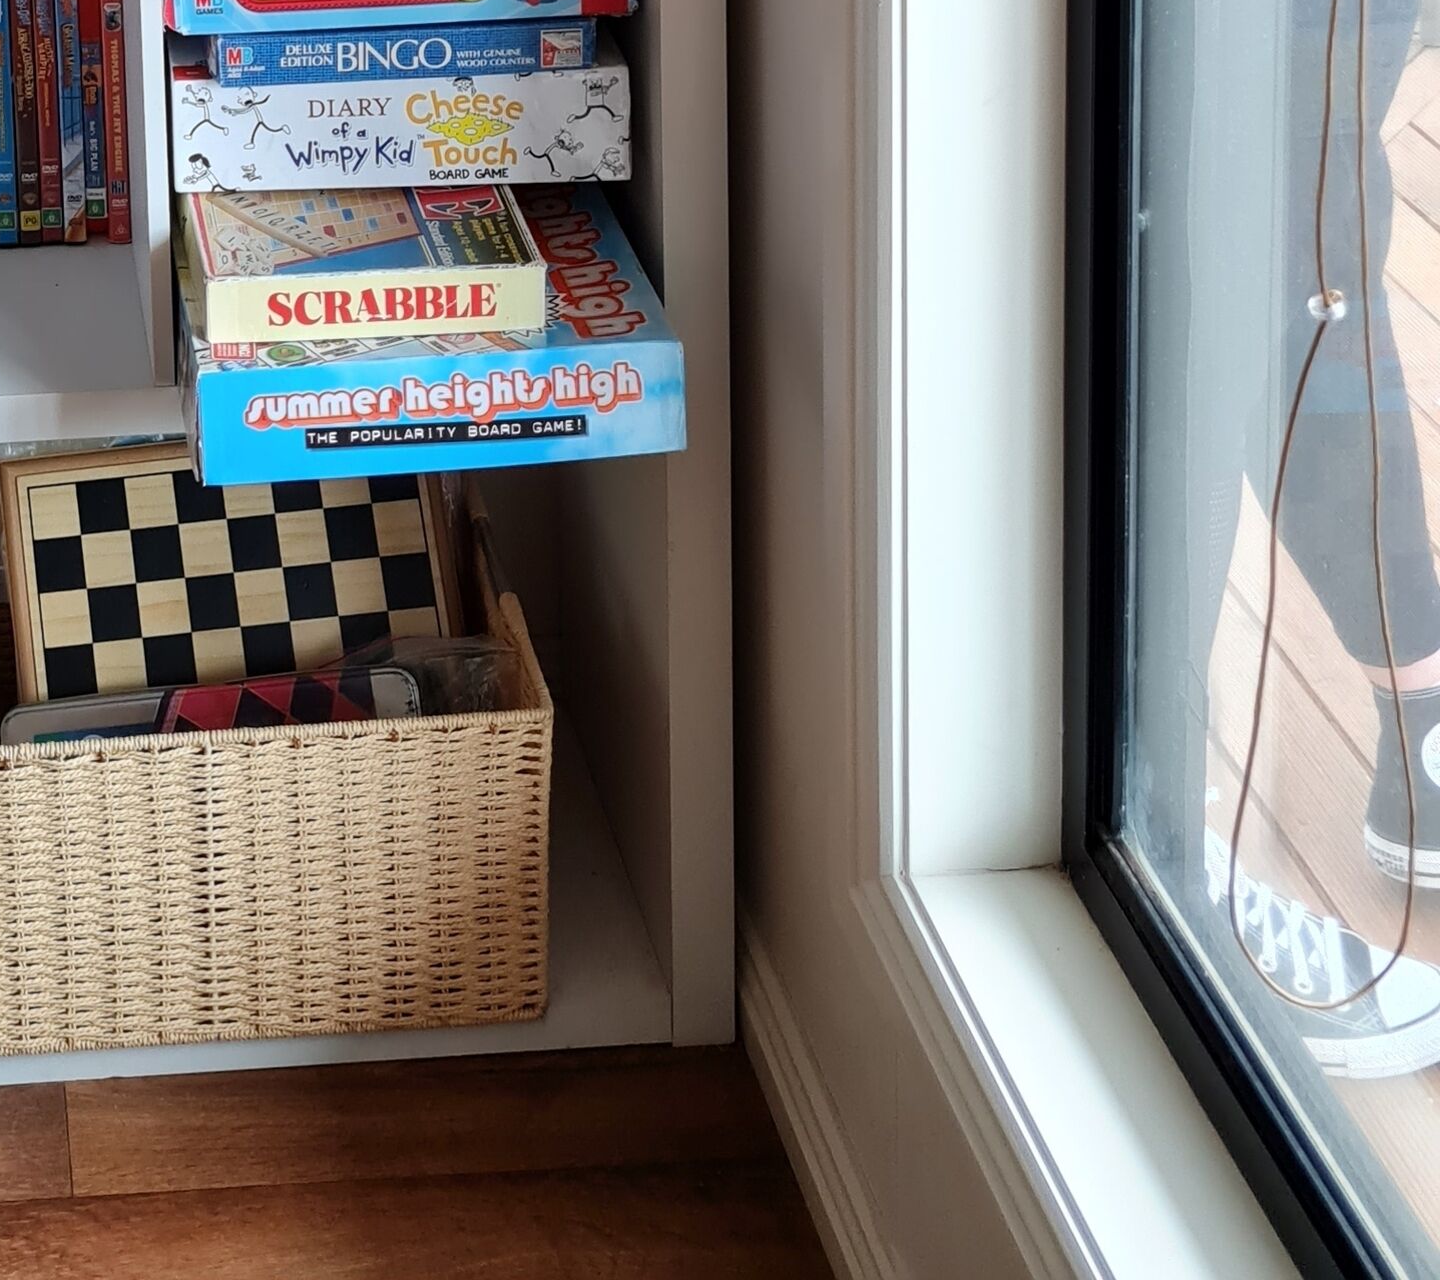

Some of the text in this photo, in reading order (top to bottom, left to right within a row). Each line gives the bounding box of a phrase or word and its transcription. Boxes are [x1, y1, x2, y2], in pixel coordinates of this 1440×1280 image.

[195, 8, 224, 16] GAMES
[226, 46, 253, 67] MB
[285, 43, 333, 56] DELUXE
[336, 38, 453, 73] BINGO
[456, 47, 522, 59] WITH GENUINE
[280, 55, 334, 68] EDITION
[456, 56, 536, 68] WOOD COUNTERS
[307, 97, 392, 119] DIARY
[405, 89, 525, 125] Cheese
[331, 121, 367, 139] of a
[284, 135, 414, 174] Wimpy Kid
[422, 137, 518, 168] Touch
[428, 167, 510, 180] BOARD GAME
[267, 282, 498, 328] SCRABBLE
[246, 361, 643, 427] summer heights high
[307, 418, 583, 445] THE POPULARITY BOARD GAME!
